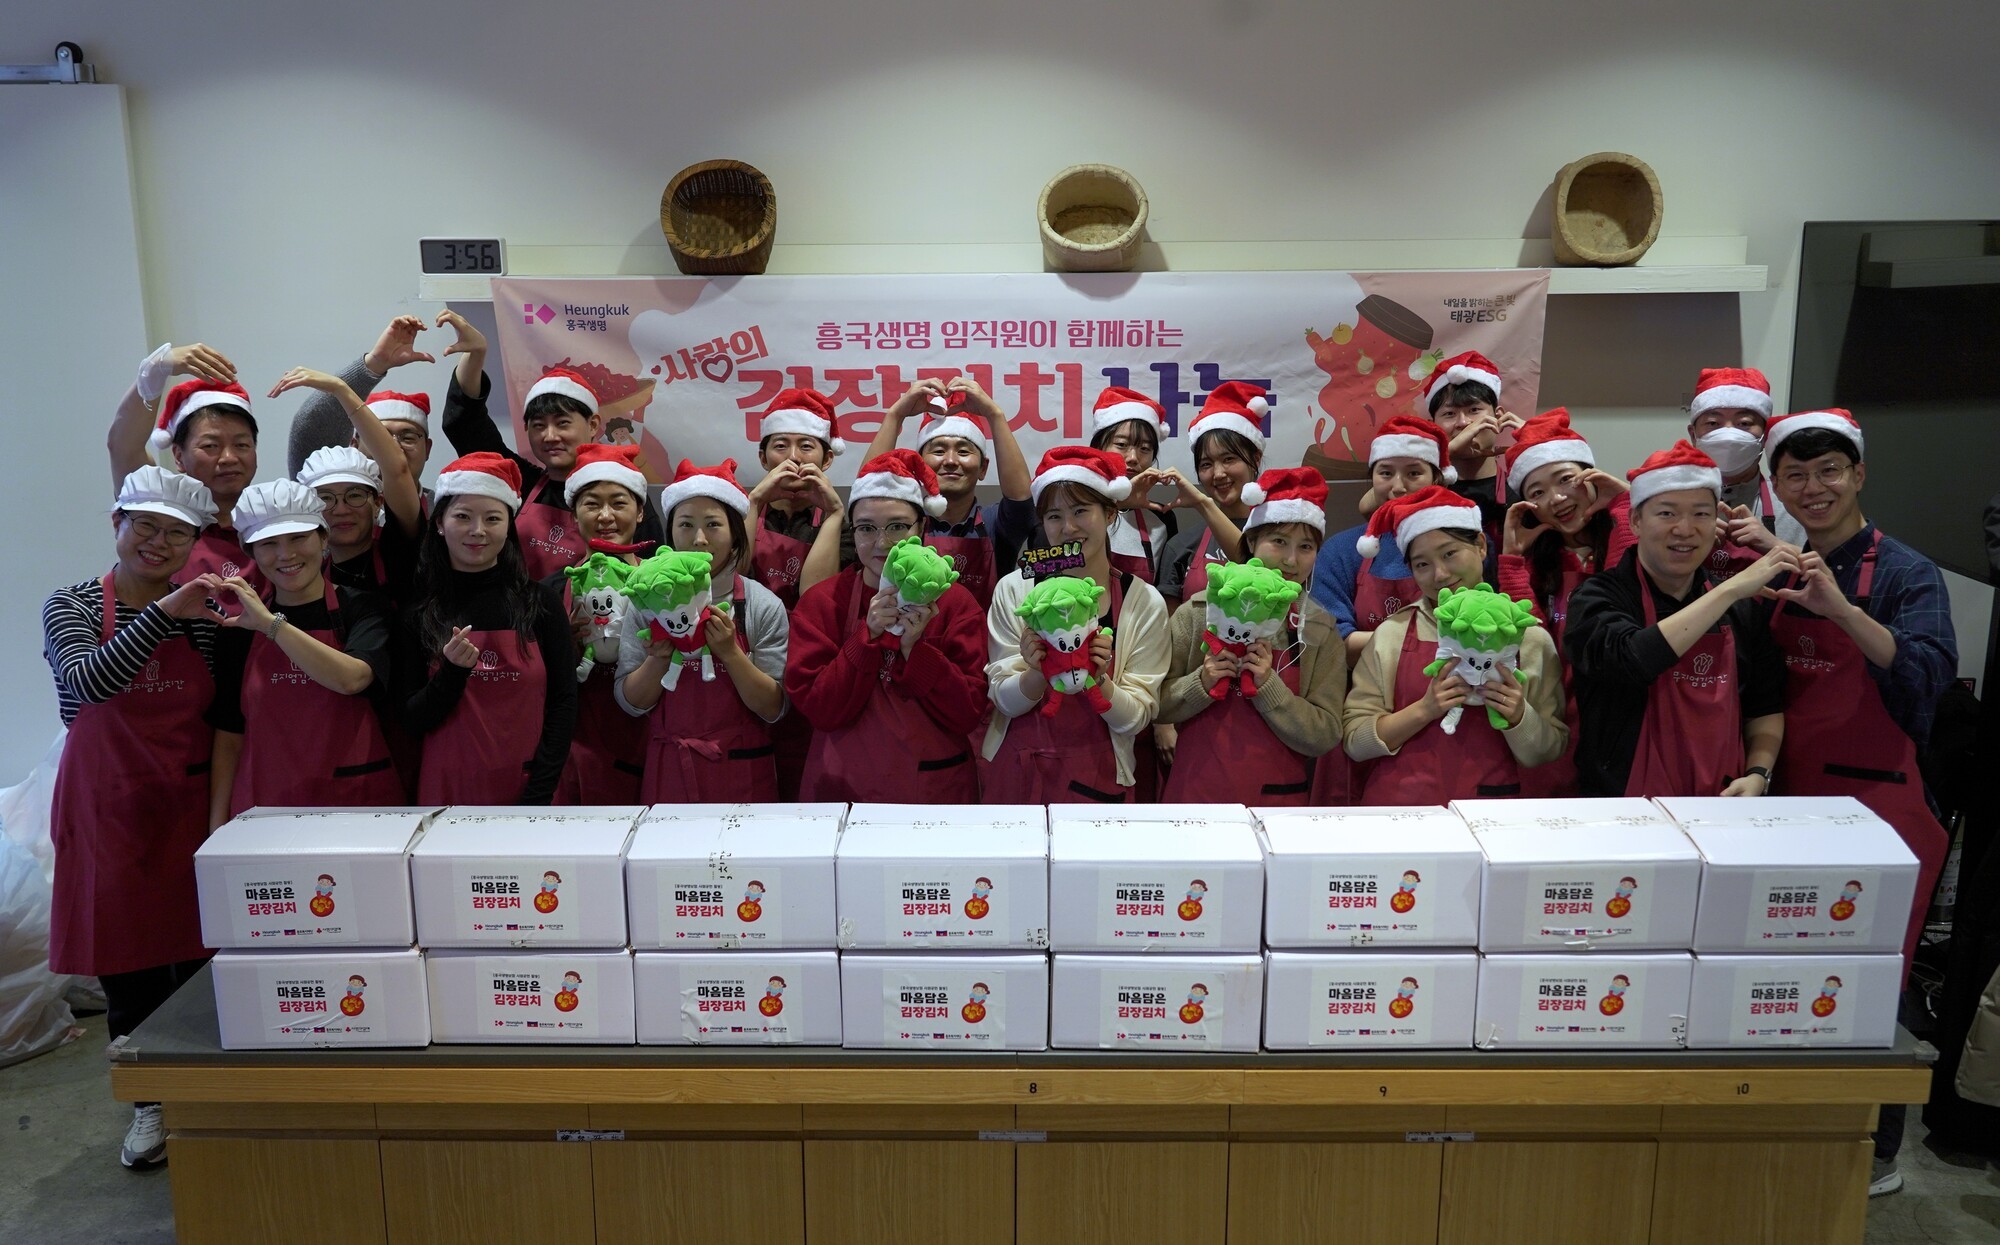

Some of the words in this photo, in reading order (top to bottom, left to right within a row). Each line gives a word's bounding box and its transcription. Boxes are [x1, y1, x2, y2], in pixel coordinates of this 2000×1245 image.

[444, 244, 494, 270] 3:56
[1443, 297, 1468, 308] 내일을
[1469, 297, 1492, 308] 밝히는
[564, 304, 630, 319] Heungkuk
[566, 319, 607, 332] 흥국생명
[816, 321, 931, 350] 흥국생명
[941, 320, 1057, 350] 임직원이
[1067, 319, 1184, 348] 함께하는
[660, 325, 769, 385] 사랑의
[270, 673, 314, 685] 뮤지엄김
[469, 670, 520, 682] 지엄김치간
[1672, 671, 1728, 687] 뮤지엄김치간
[246, 887, 295, 900] 마음담은
[471, 881, 520, 894] 마음담은
[1329, 880, 1378, 894] 마음담은
[1544, 887, 1594, 900] 마음담은
[674, 890, 724, 903] 마음담은
[902, 888, 951, 901] 마음담은
[1116, 889, 1165, 902] 마음담은
[1768, 891, 1818, 904] 마음담은
[473, 896, 521, 909] 김장김치
[1329, 895, 1377, 909] 김장김치
[1544, 902, 1593, 915] 김장김치
[249, 902, 298, 916] 김장김치
[676, 905, 724, 918] 김장김치
[903, 903, 952, 916] 김장김치
[1116, 903, 1165, 916] 김장김치
[1768, 908, 1816, 918] 김장김치
[493, 976, 541, 993] 마음담은
[1539, 984, 1588, 997] 마음담은
[276, 985, 326, 999] 마음담은
[697, 985, 746, 998] 마음담은
[900, 992, 949, 1004] 마음담은
[1328, 987, 1377, 1000] 마음담은
[1751, 987, 1800, 1000] 마음담은
[494, 993, 541, 1007] 김장김치
[1118, 992, 1167, 1005] 마음담은
[1538, 999, 1586, 1011] 김장김치
[279, 1000, 327, 1013] 김장김치
[699, 999, 746, 1013] 김장김치
[901, 1006, 949, 1019] 김장김치
[1119, 1006, 1166, 1019] 김장김치
[1328, 1002, 1376, 1015] 김장김치
[1751, 1002, 1798, 1014] 김장김치
[1029, 1082, 1037, 1094] 8
[1379, 1086, 1387, 1097] 9
[1737, 1083, 1749, 1095] 10
